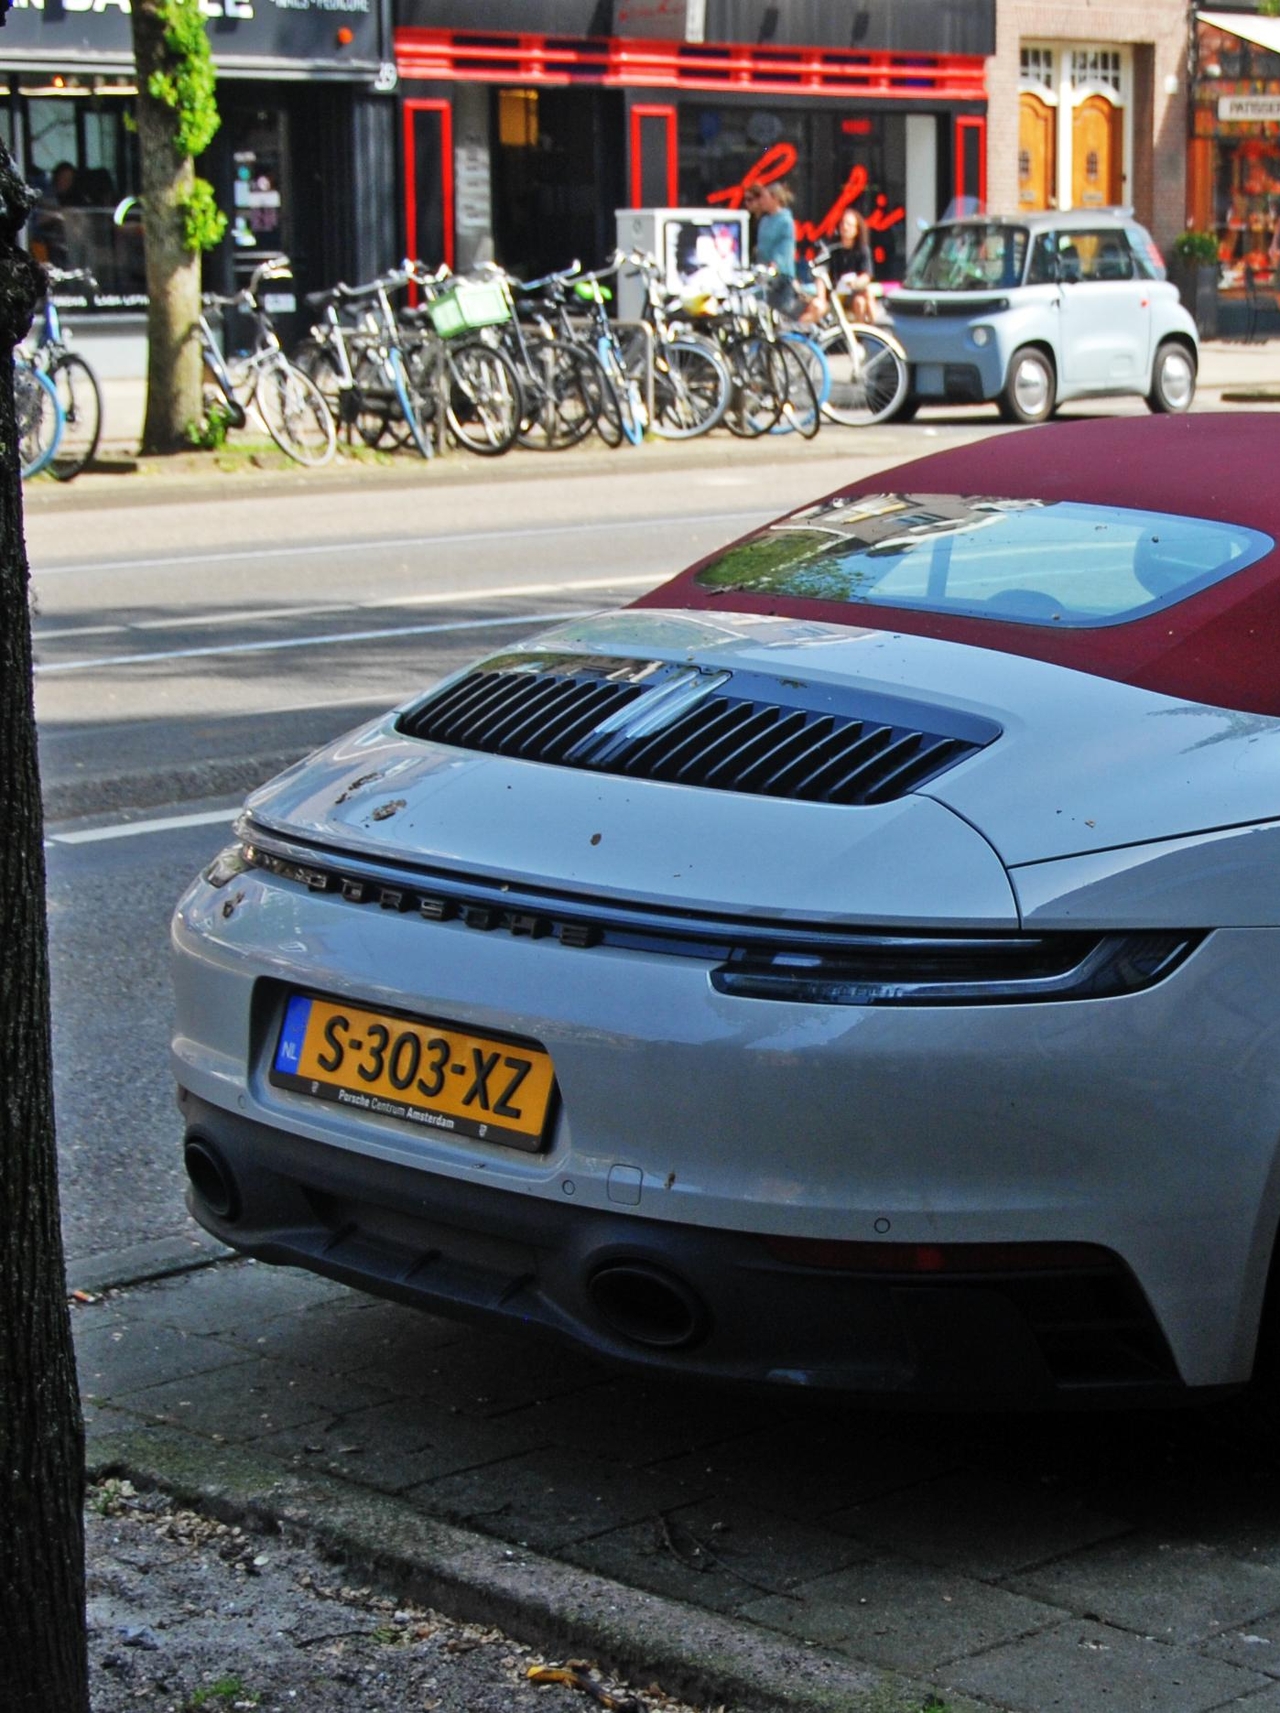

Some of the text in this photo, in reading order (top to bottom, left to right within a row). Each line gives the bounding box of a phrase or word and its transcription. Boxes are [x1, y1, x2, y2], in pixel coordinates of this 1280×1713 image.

[280, 1040, 298, 1061] NL
[317, 1015, 532, 1119] S-303-XZ
[338, 1089, 454, 1129] Porsche Centrum Amsterdam
